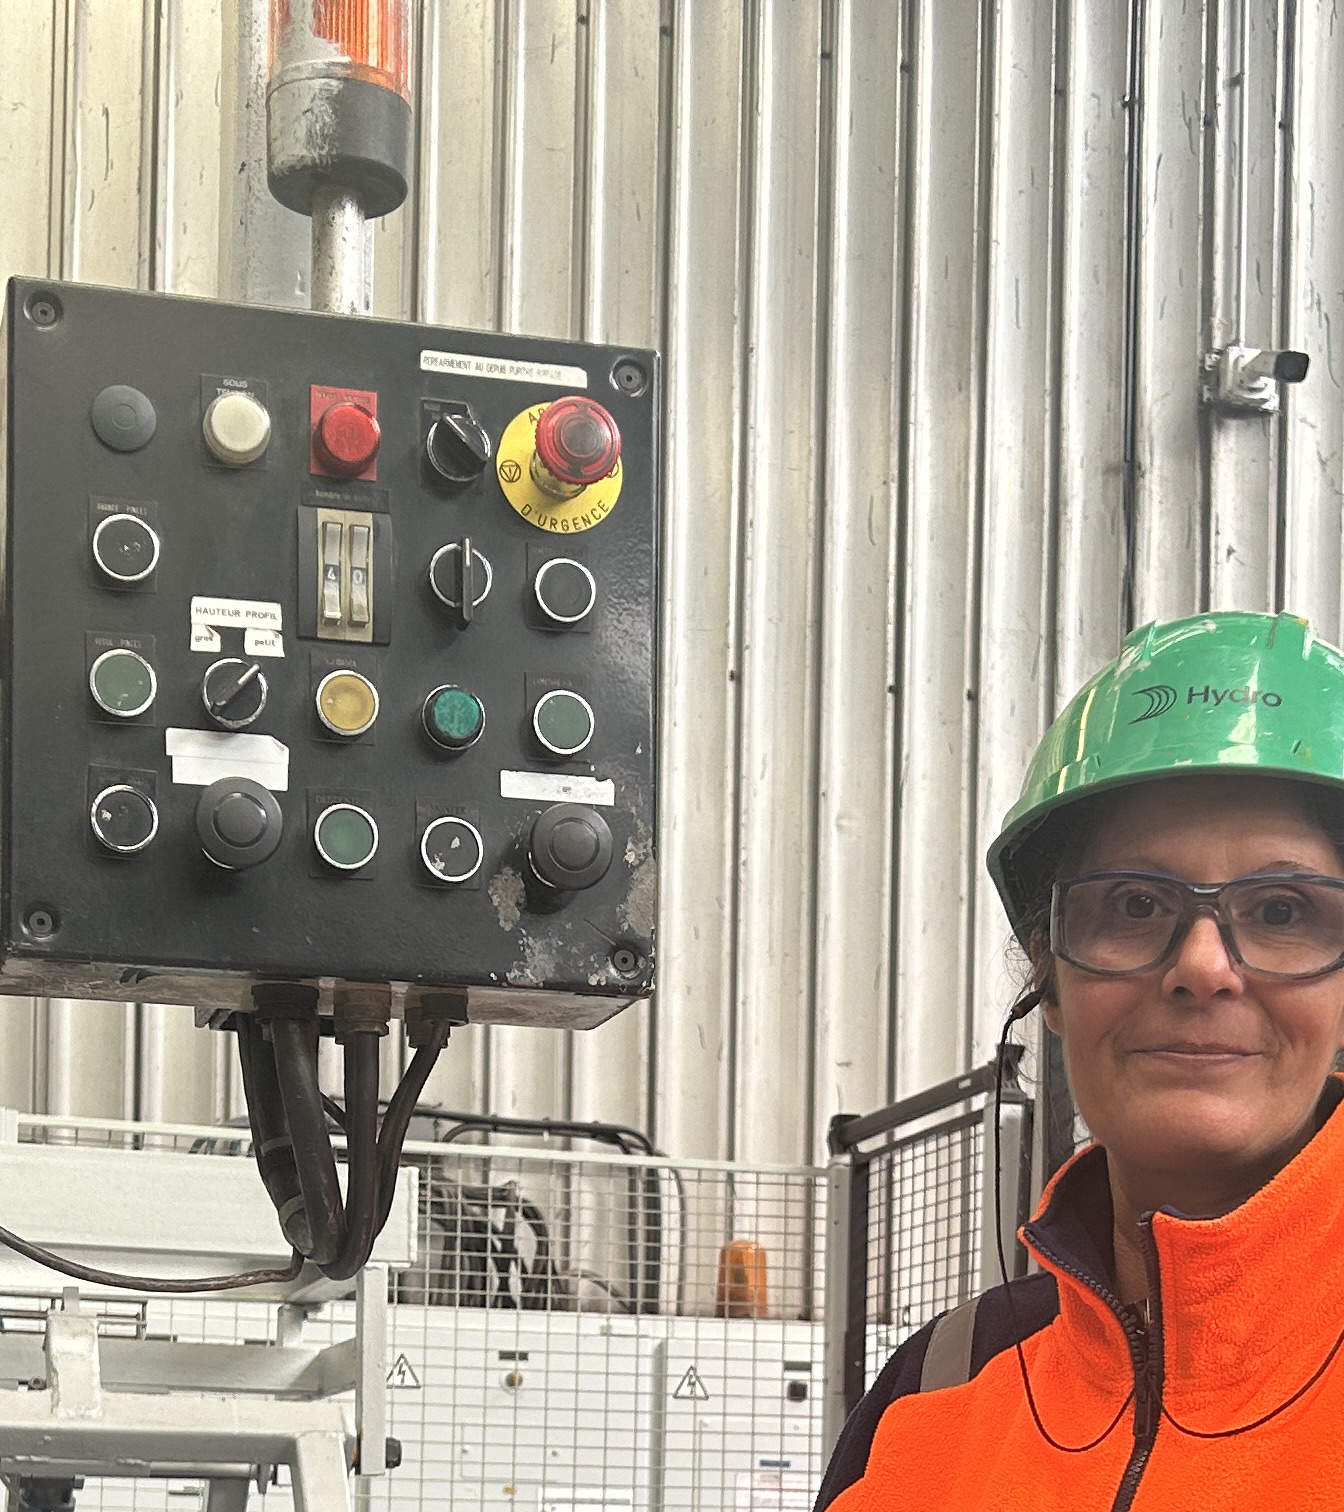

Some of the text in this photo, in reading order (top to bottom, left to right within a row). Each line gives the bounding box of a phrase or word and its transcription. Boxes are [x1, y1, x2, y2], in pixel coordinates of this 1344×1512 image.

[222, 378, 248, 388] SOUS
[521, 499, 610, 531] D'URGENCE
[195, 606, 278, 620] HAUTEUR PROFIL
[1187, 684, 1283, 709] Hydro
